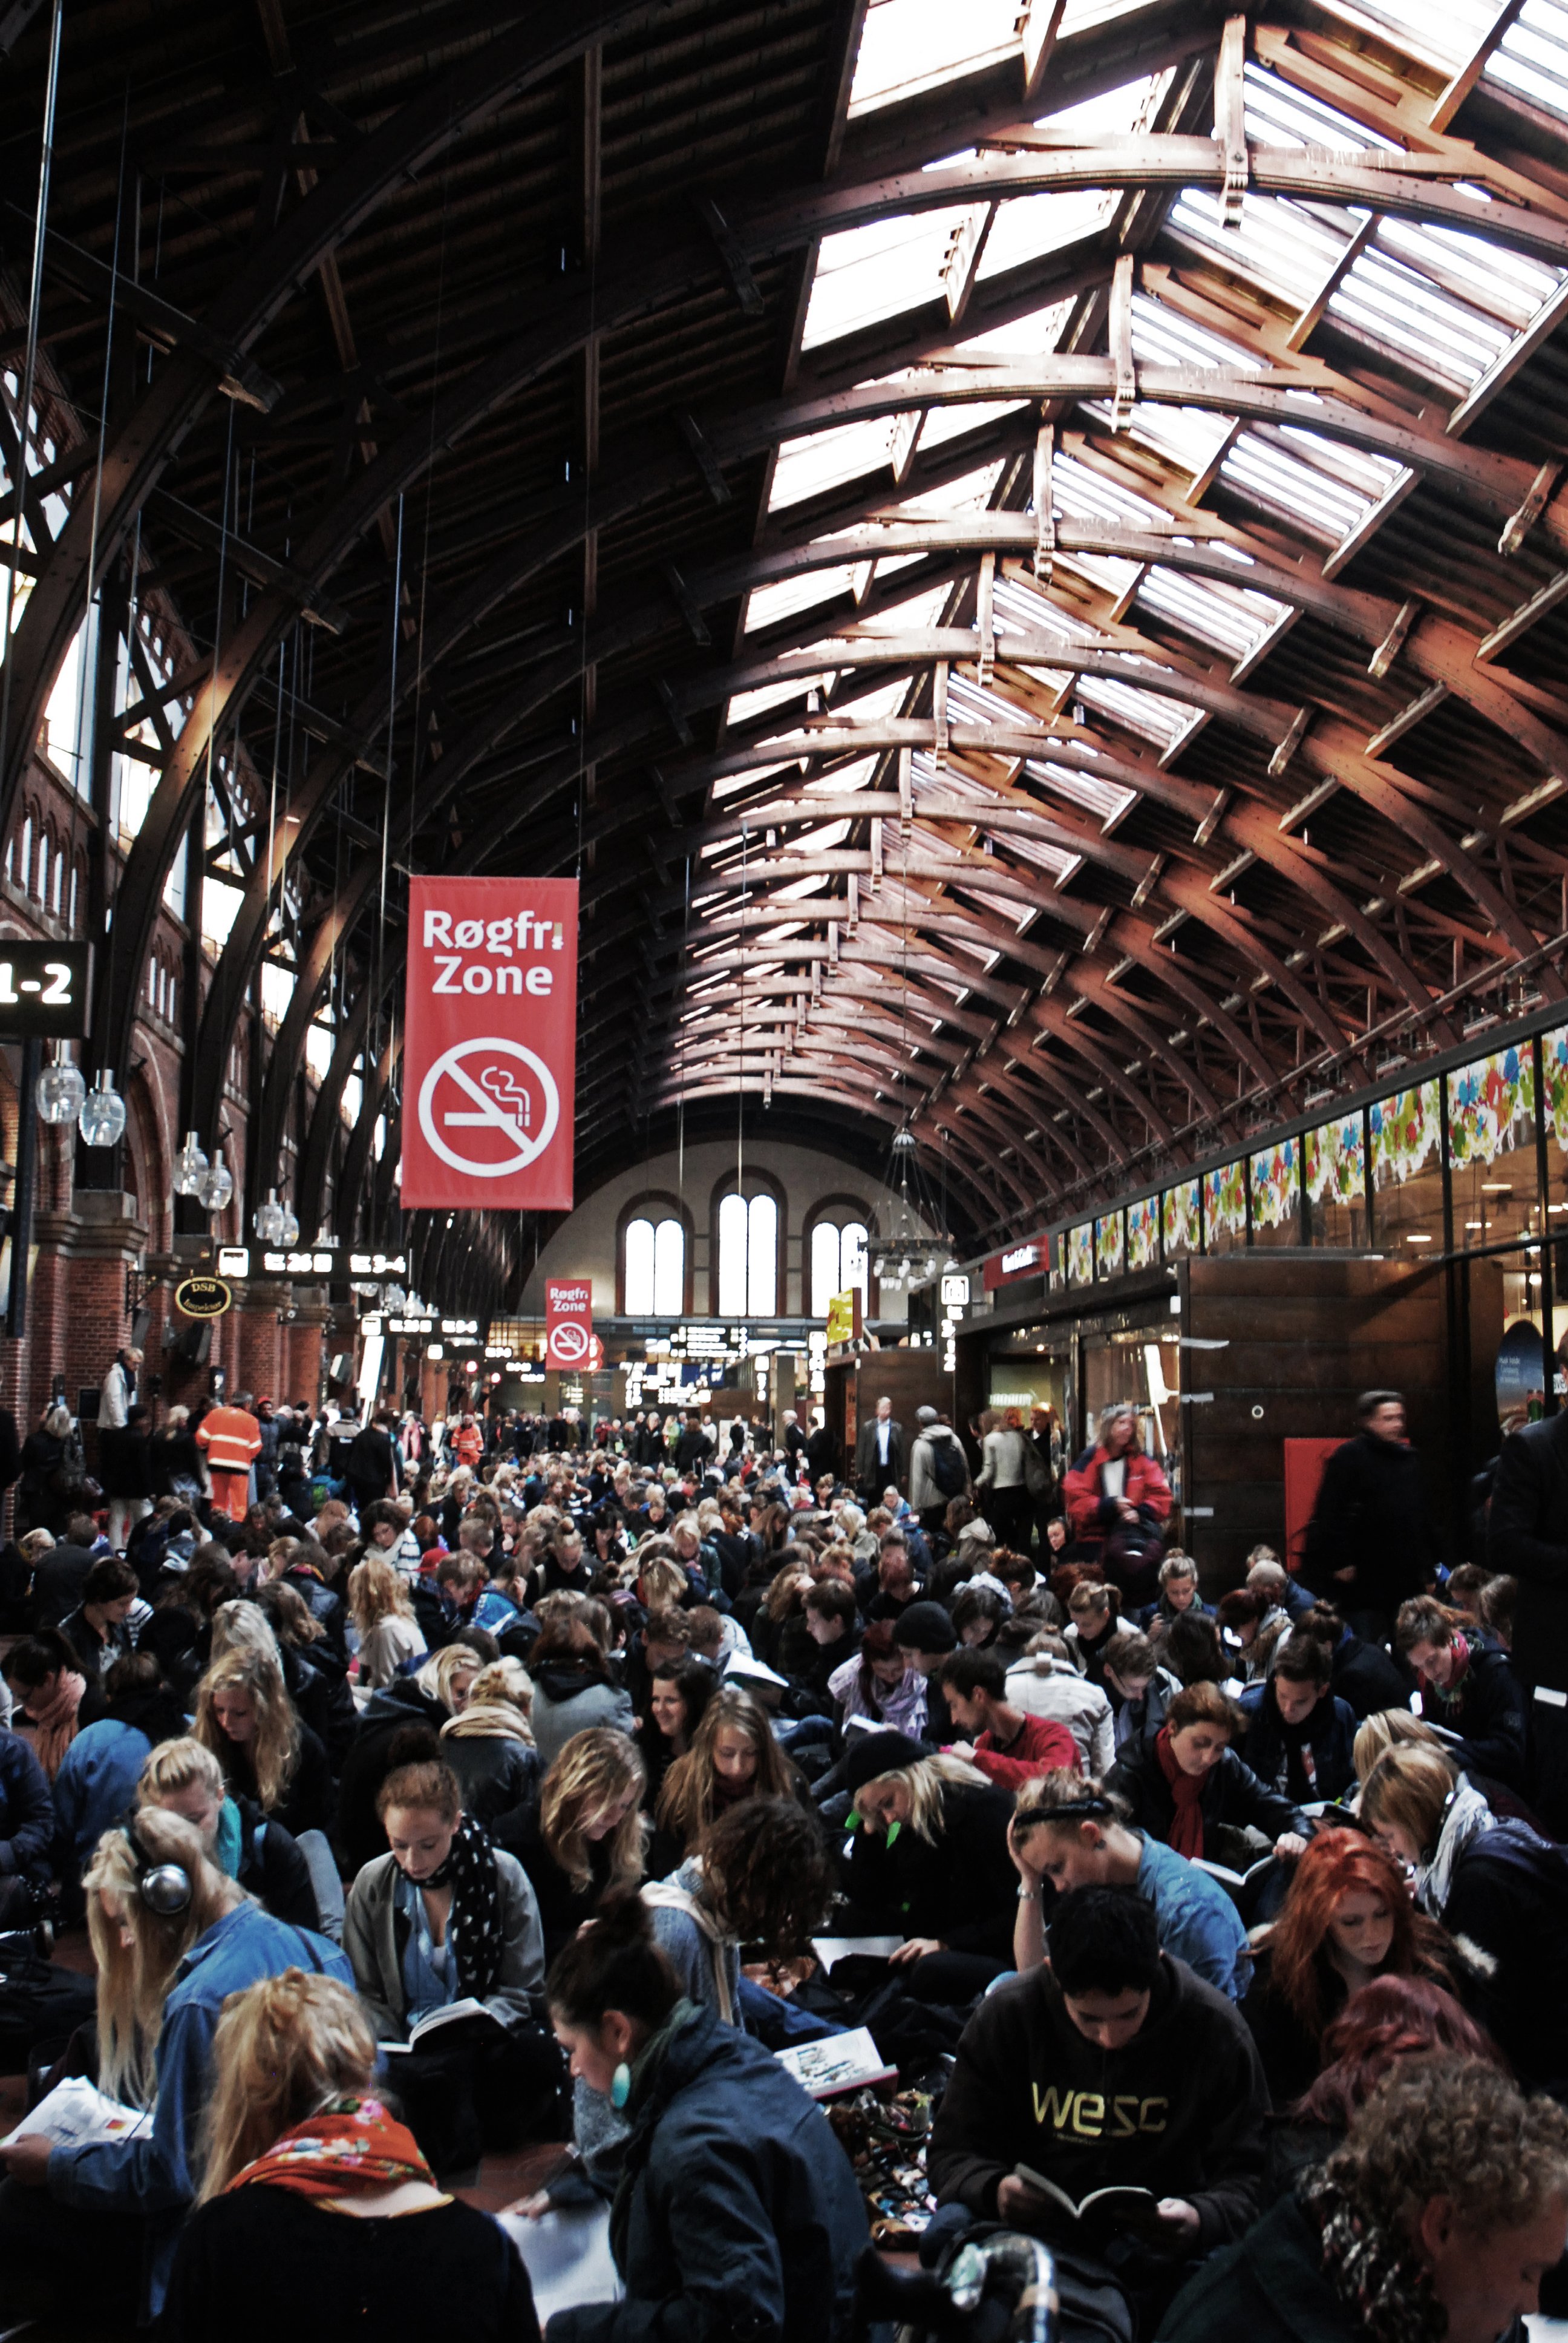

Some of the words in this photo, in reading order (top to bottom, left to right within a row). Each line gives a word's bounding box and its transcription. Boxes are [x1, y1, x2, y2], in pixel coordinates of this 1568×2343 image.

[0, 963, 72, 1004] 1-2
[432, 955, 553, 995] Zone
[191, 1283, 216, 1293] DSB
[553, 1300, 586, 1312] Zone
